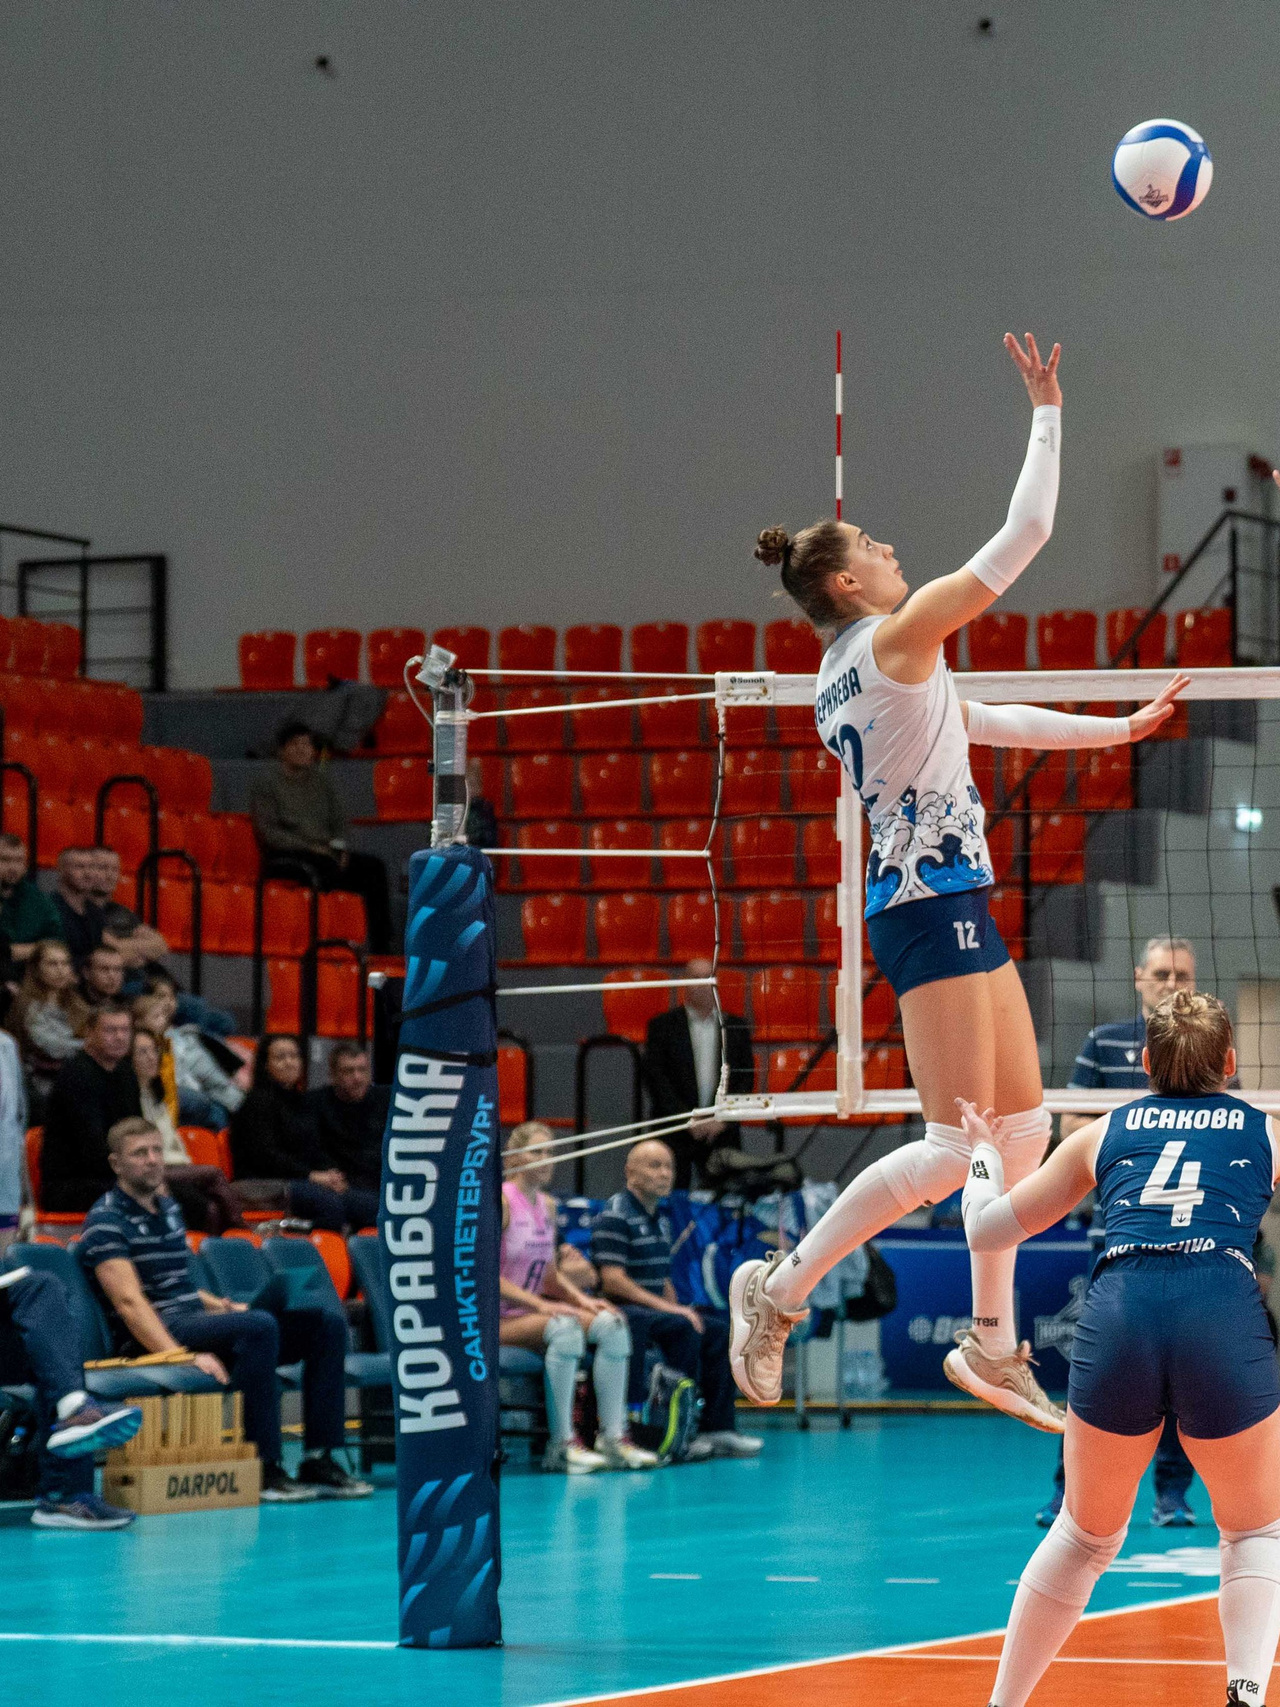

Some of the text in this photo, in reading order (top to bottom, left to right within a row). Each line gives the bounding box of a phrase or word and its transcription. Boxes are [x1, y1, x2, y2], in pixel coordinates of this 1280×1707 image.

[815, 666, 862, 727] ЕРНЯЕВА
[953, 920, 980, 950] 12
[1125, 1106, 1245, 1131] ИСАКОВА
[1139, 1140, 1205, 1227] 4
[384, 1052, 468, 1434] КОРАБЕЛКА
[453, 1094, 494, 1381] САНКТ-ПЕТЕРБУРГ
[165, 1471, 239, 1499] DARPOL
